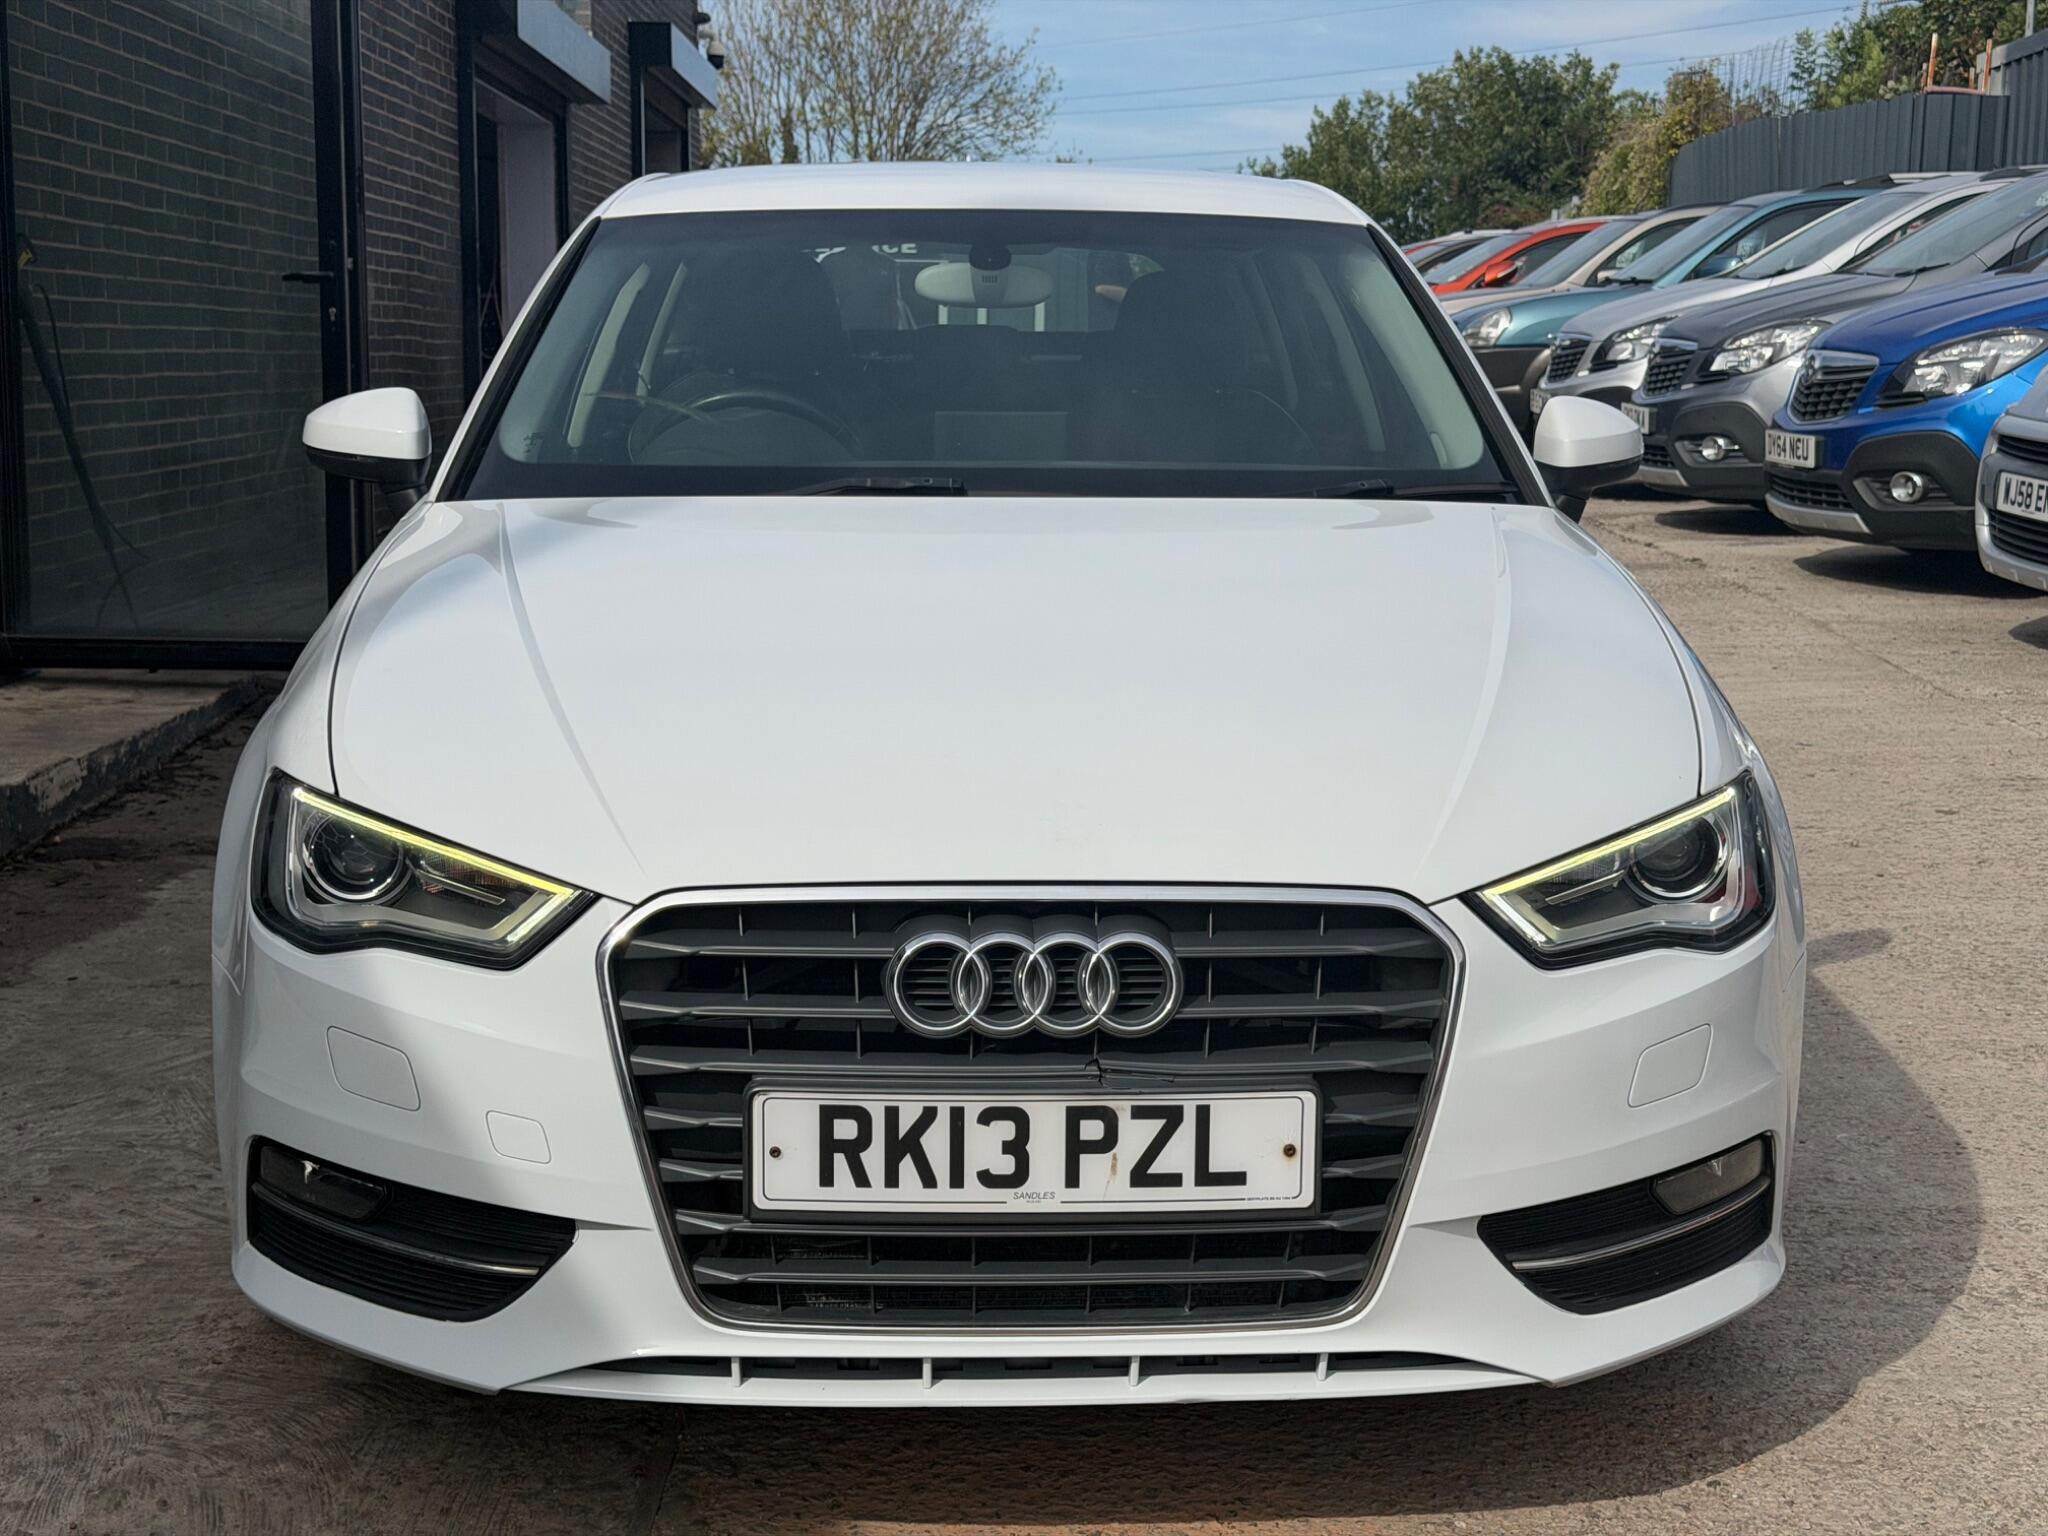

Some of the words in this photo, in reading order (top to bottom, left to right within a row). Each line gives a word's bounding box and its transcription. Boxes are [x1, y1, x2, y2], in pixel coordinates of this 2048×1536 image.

[1789, 435, 1809, 461] NEU
[2003, 476, 2033, 510] WJ58
[819, 1104, 1029, 1189] RK13
[1065, 1104, 1247, 1189] PZL
[1013, 1191, 1056, 1200] SANDLES
